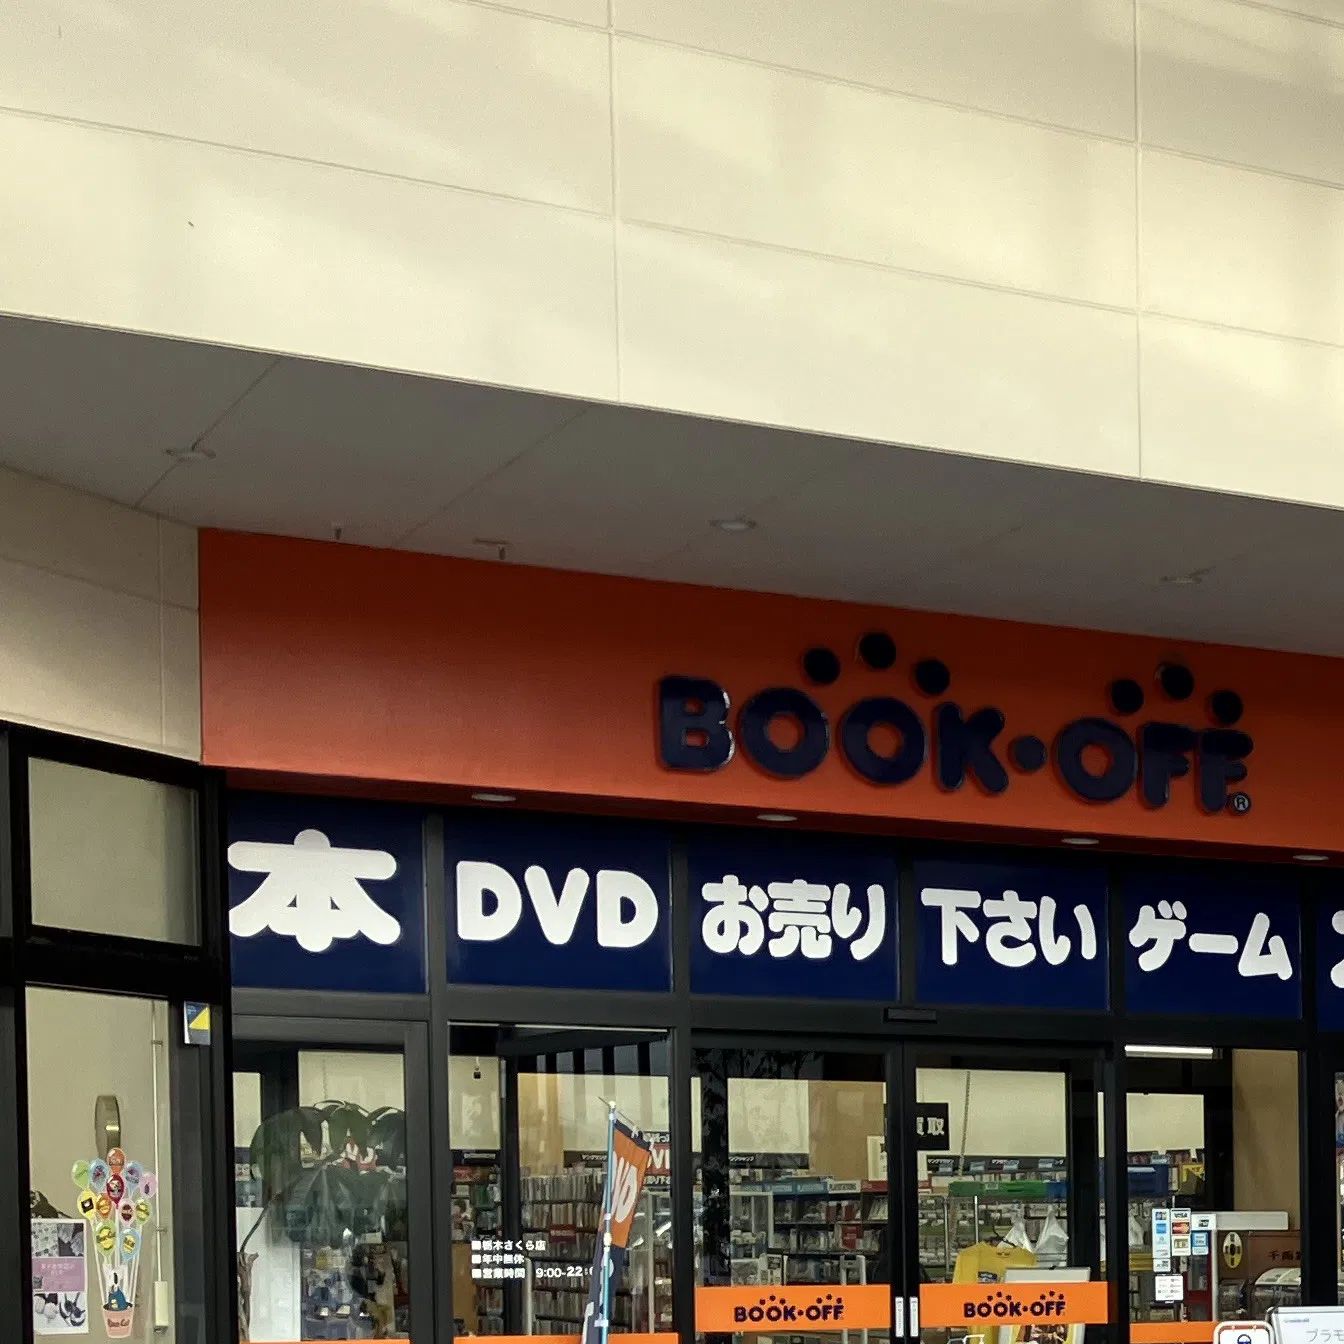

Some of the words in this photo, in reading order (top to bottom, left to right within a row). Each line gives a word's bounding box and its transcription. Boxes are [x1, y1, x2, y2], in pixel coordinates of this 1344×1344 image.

[227, 829, 401, 952] 本
[457, 860, 659, 948] DVD
[701, 874, 886, 961] お売り
[920, 886, 1098, 968] 下さい
[1128, 899, 1294, 982] ゲーム
[482, 1254, 525, 1265] 年中無休
[482, 1267, 526, 1279] 営業時間
